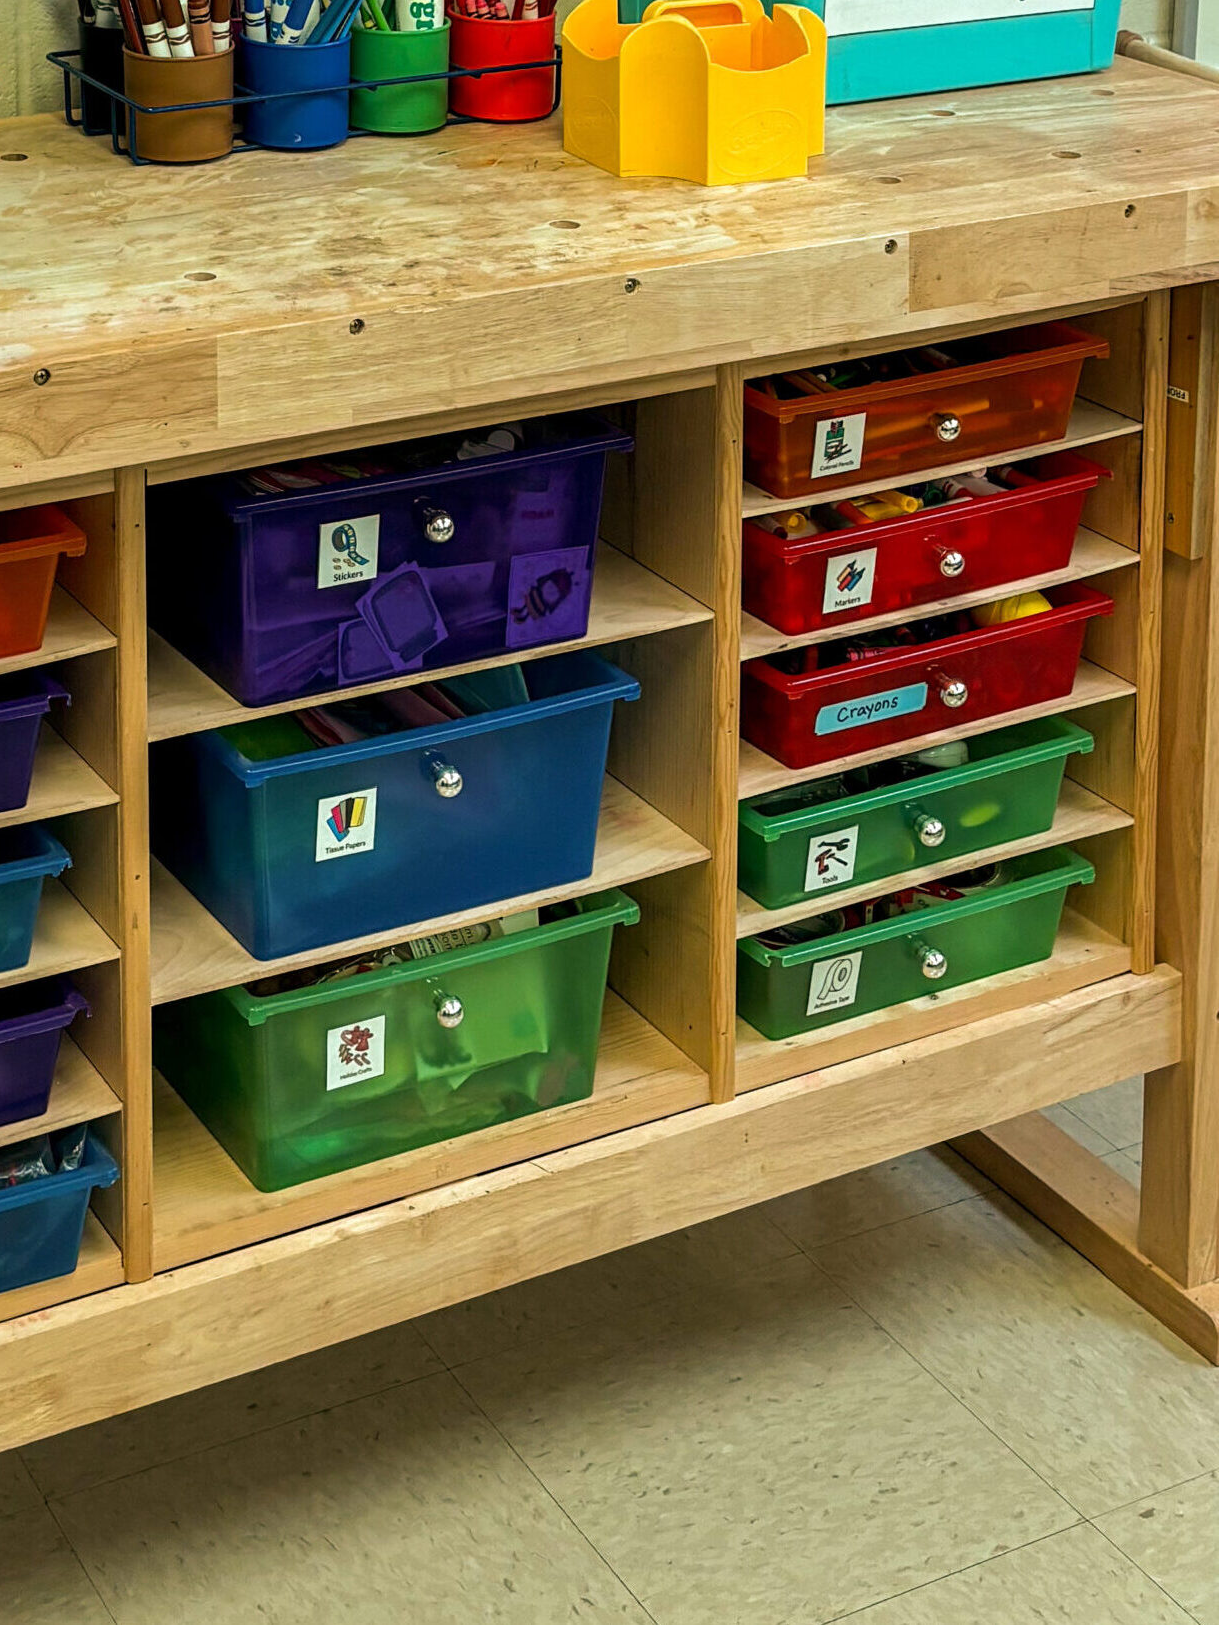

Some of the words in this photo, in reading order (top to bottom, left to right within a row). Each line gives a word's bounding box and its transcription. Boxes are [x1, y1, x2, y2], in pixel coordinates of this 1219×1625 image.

[333, 569, 364, 582] Stickers
[835, 597, 861, 607] Markers
[837, 696, 899, 723] Crayons
[325, 844, 344, 854] Tissue
[345, 840, 366, 851] Papers
[822, 875, 839, 884] Tools
